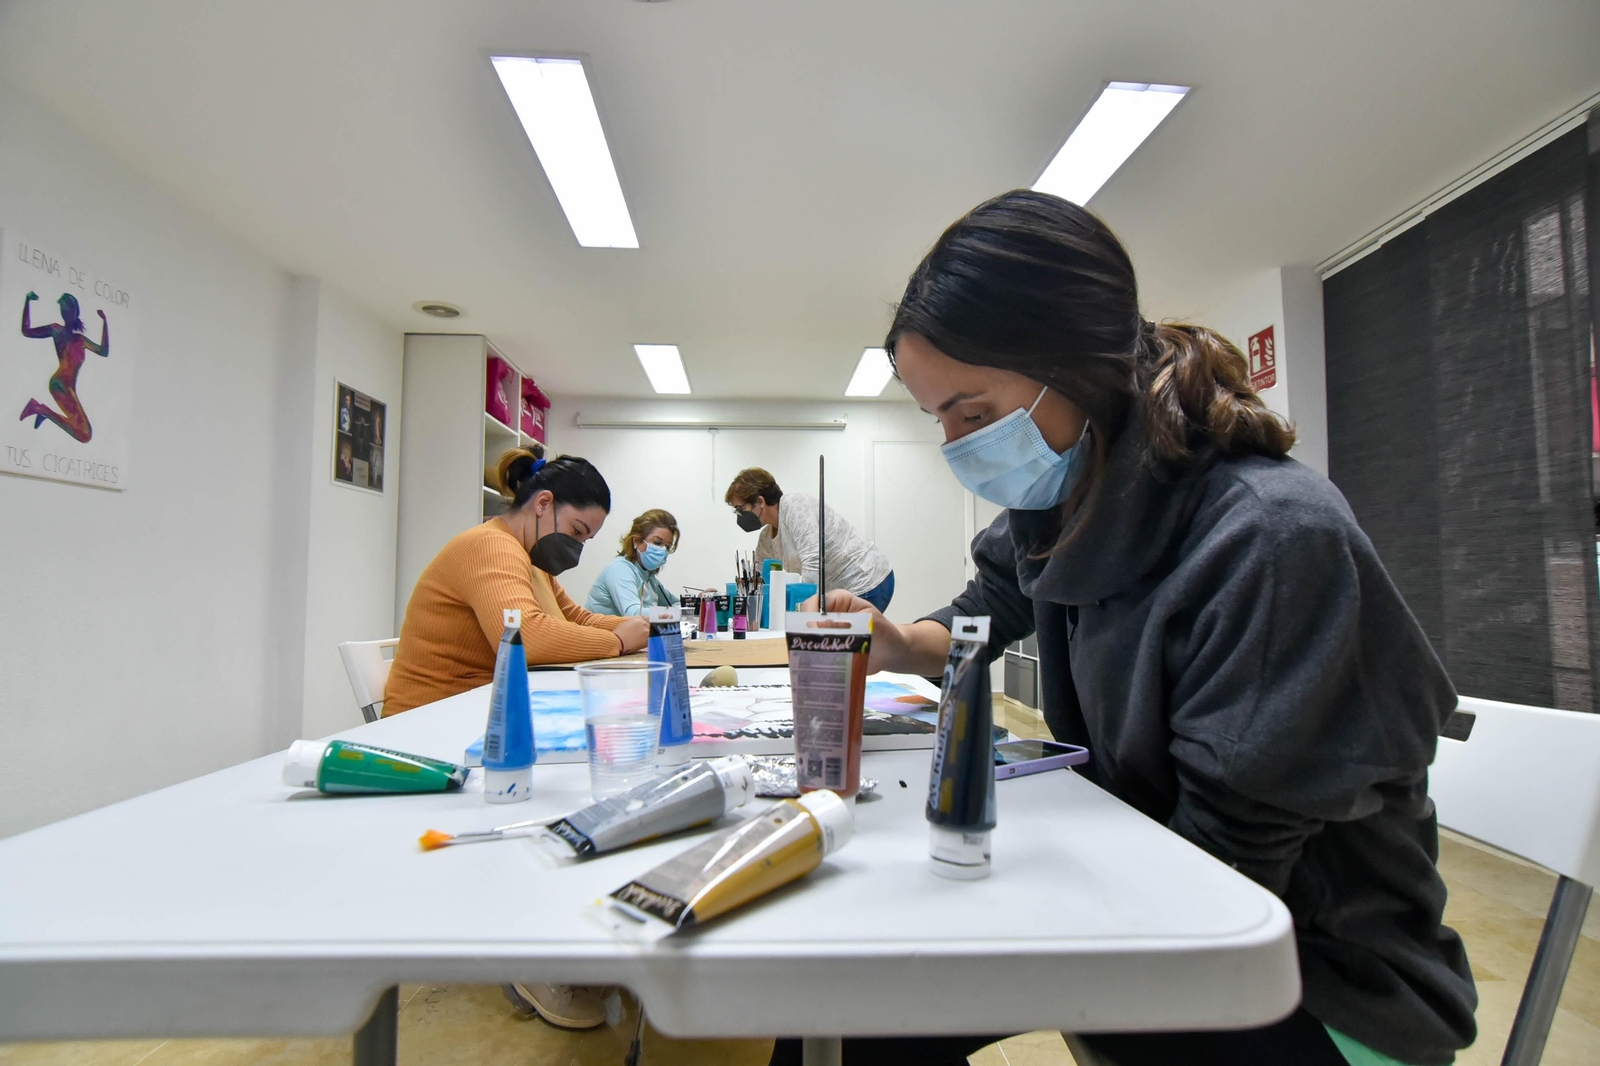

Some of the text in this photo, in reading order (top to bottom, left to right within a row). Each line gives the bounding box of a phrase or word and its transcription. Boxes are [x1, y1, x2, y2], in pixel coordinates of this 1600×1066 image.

[19, 242, 130, 308] LLENA DE COLOR
[6, 445, 119, 484] TUS CICATRICES
